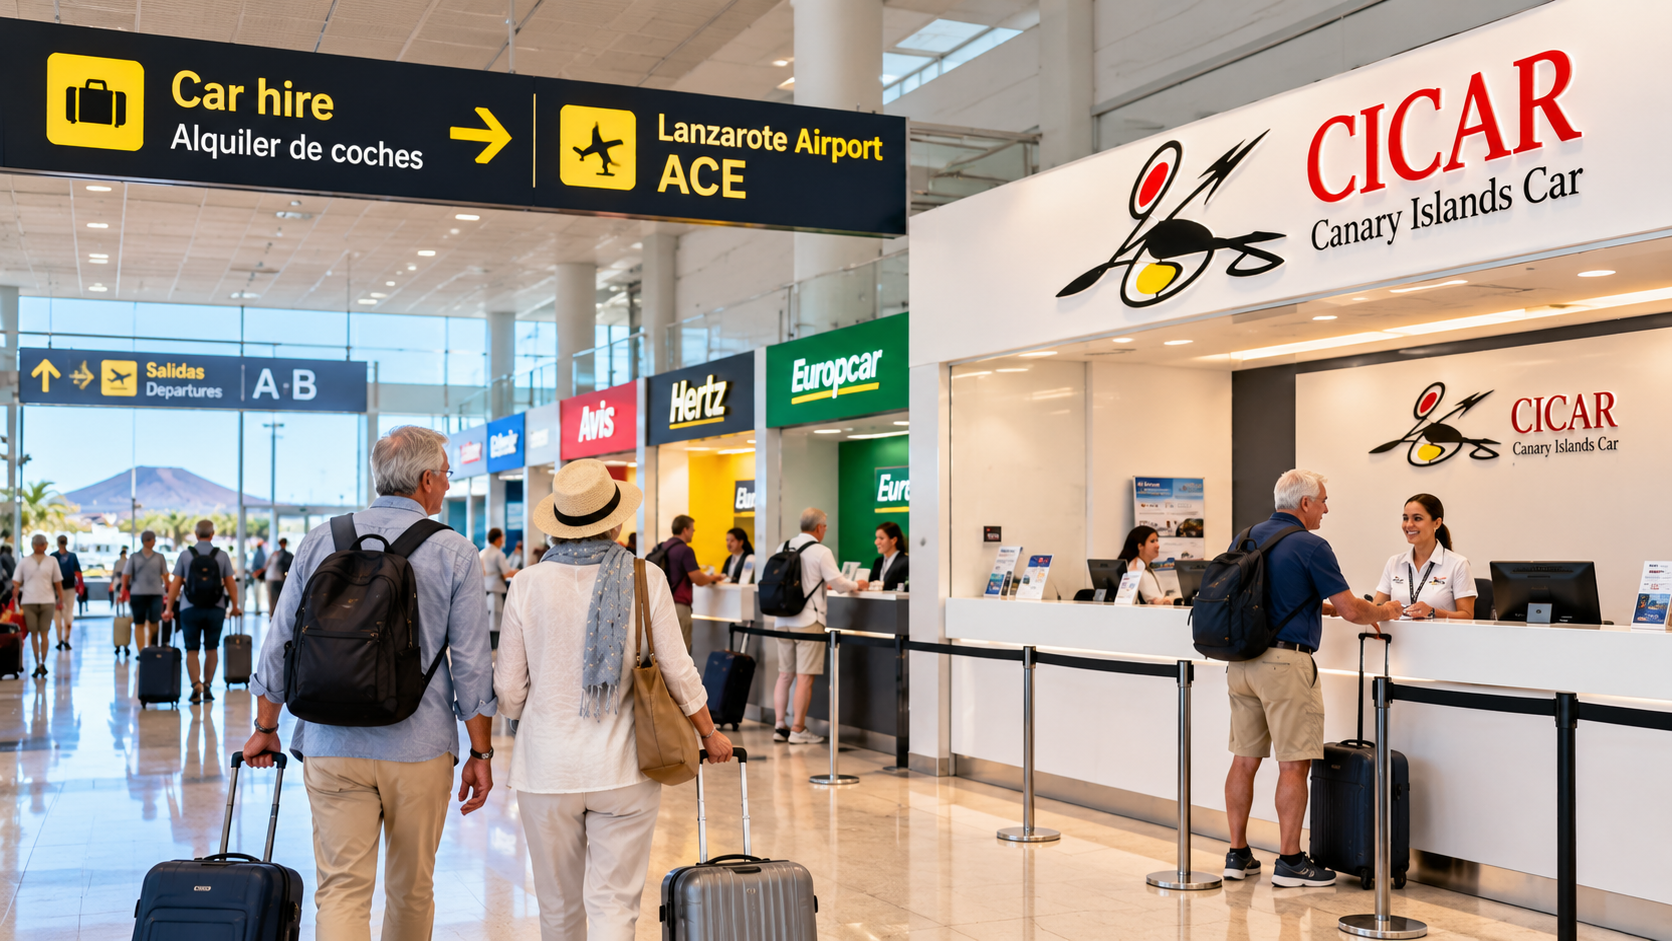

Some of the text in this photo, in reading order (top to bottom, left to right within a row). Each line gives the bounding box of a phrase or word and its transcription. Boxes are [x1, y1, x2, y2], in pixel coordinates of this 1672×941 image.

[171, 69, 334, 121] Car hire
[170, 123, 424, 170] Alquiler de coches
[657, 113, 884, 164] Lanzarote Airport
[1307, 49, 1583, 204] CICAR
[657, 154, 747, 200] ACE
[1311, 166, 1584, 254] Canary Islands Car
[146, 361, 205, 380] Salidas
[146, 381, 223, 400] Departures
[792, 348, 883, 399] Europcar
[578, 399, 615, 443] Avis
[669, 373, 728, 423] Hertz
[1511, 391, 1619, 434] CICAR
[1512, 436, 1619, 458] Canary Islands Car
